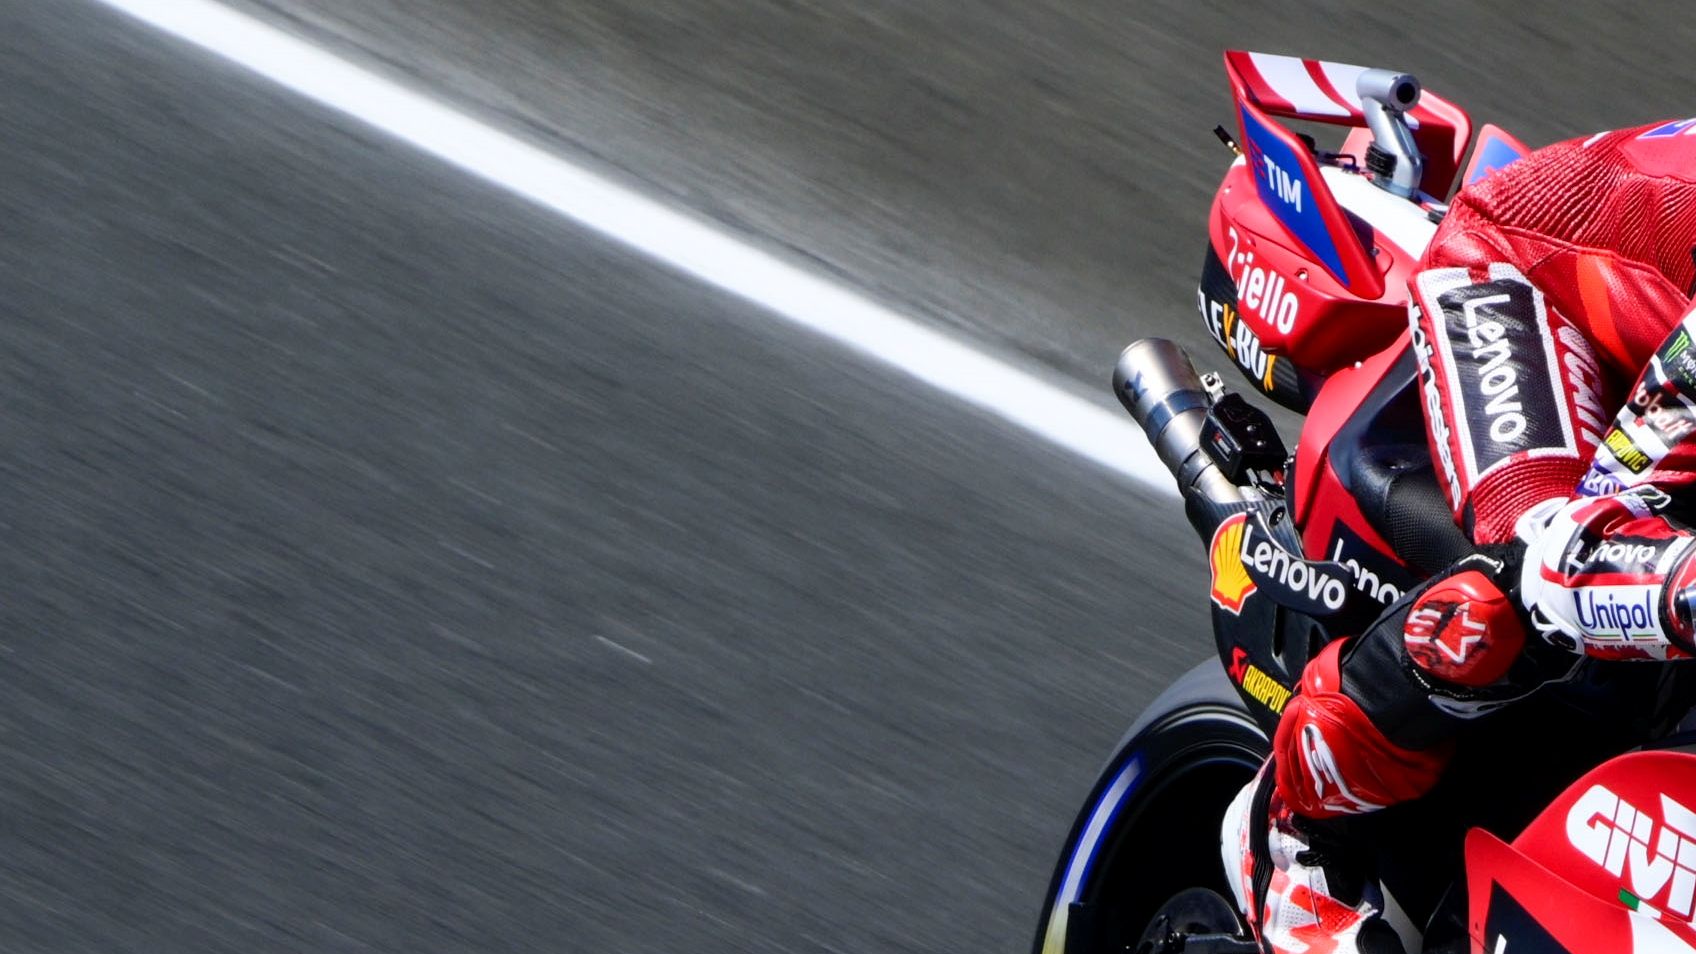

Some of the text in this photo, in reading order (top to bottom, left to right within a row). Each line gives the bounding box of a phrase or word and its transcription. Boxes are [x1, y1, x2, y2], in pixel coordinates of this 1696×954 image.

[1264, 154, 1302, 213] TIM
[1463, 294, 1527, 442] Lenovo
[1240, 524, 1346, 610] Lenovo
[1573, 588, 1655, 642] Unipol
